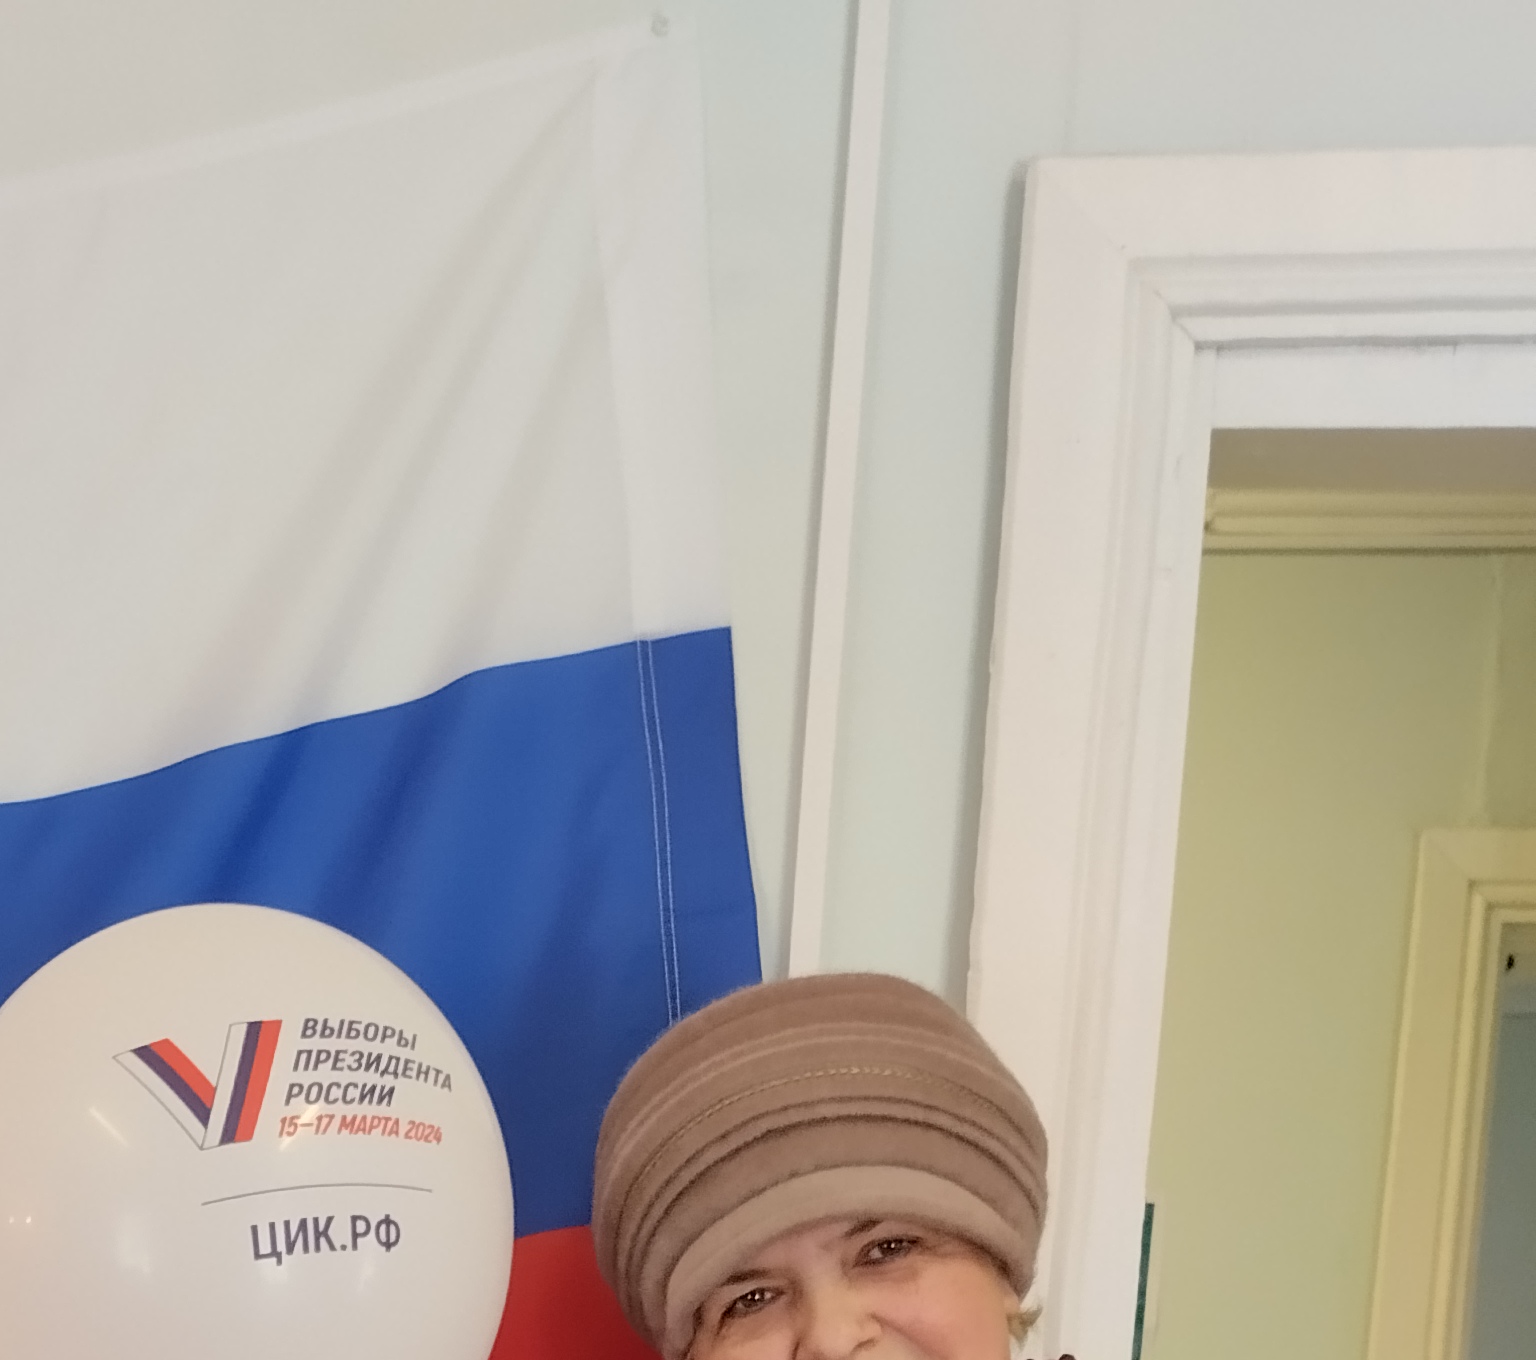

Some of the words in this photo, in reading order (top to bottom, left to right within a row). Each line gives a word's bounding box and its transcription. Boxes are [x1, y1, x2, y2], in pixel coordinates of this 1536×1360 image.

[300, 1017, 418, 1051] ВЫБОРЫ
[292, 1049, 452, 1093] ПРЕЗИДЕНТА
[283, 1081, 396, 1108] РОССИИ
[337, 1114, 400, 1139] МАРТА
[404, 1119, 444, 1146] 2024
[250, 1213, 402, 1267] ЦИК.РФ
